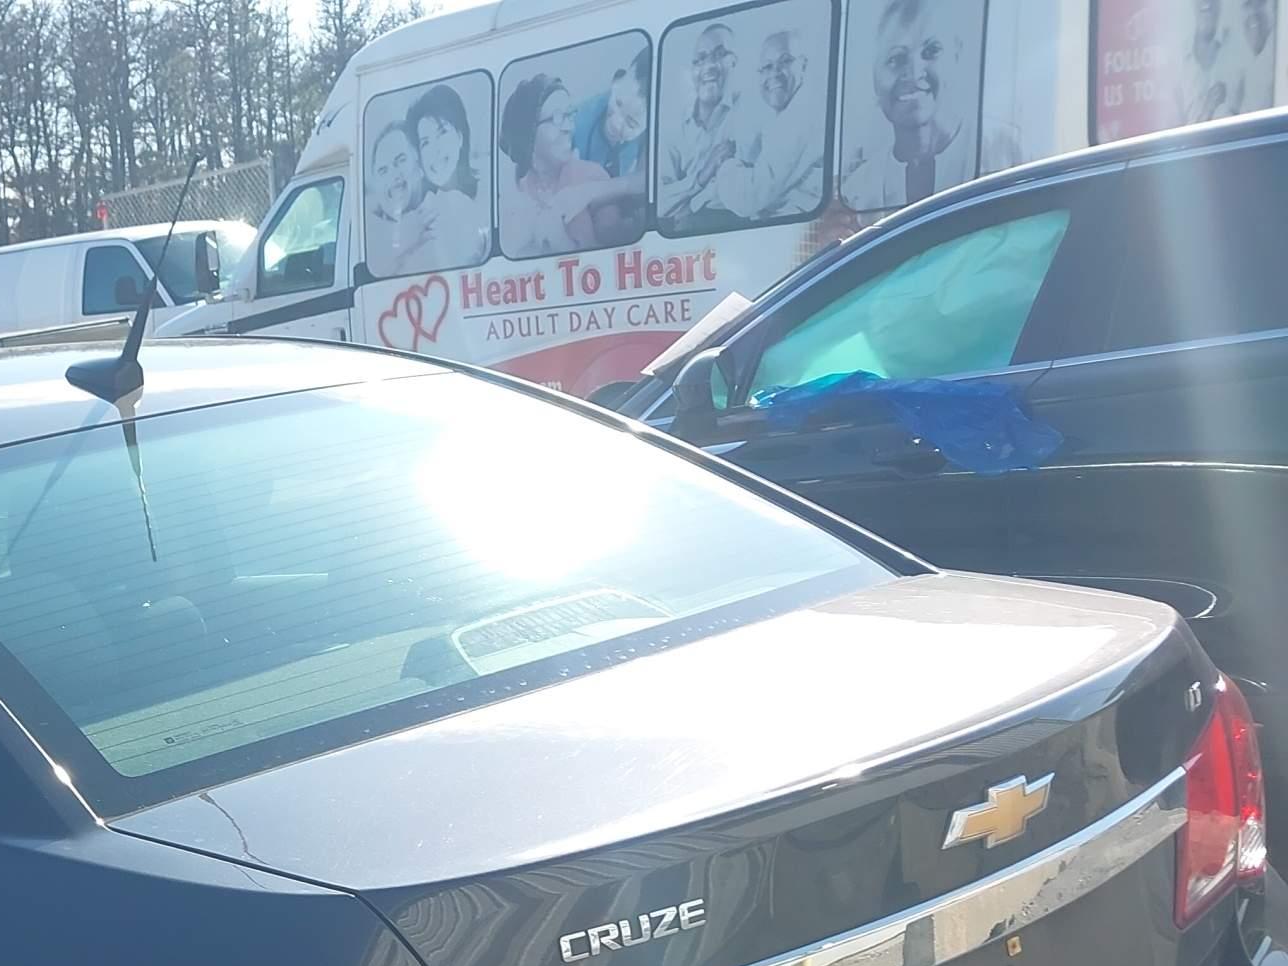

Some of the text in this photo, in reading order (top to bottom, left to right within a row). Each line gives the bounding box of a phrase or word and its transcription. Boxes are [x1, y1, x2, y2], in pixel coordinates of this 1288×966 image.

[1103, 80, 1153, 107] US TO
[460, 248, 718, 310] Heart To Heart
[486, 299, 693, 341] ADULT DAY CARE
[559, 898, 707, 963] CRUZE
